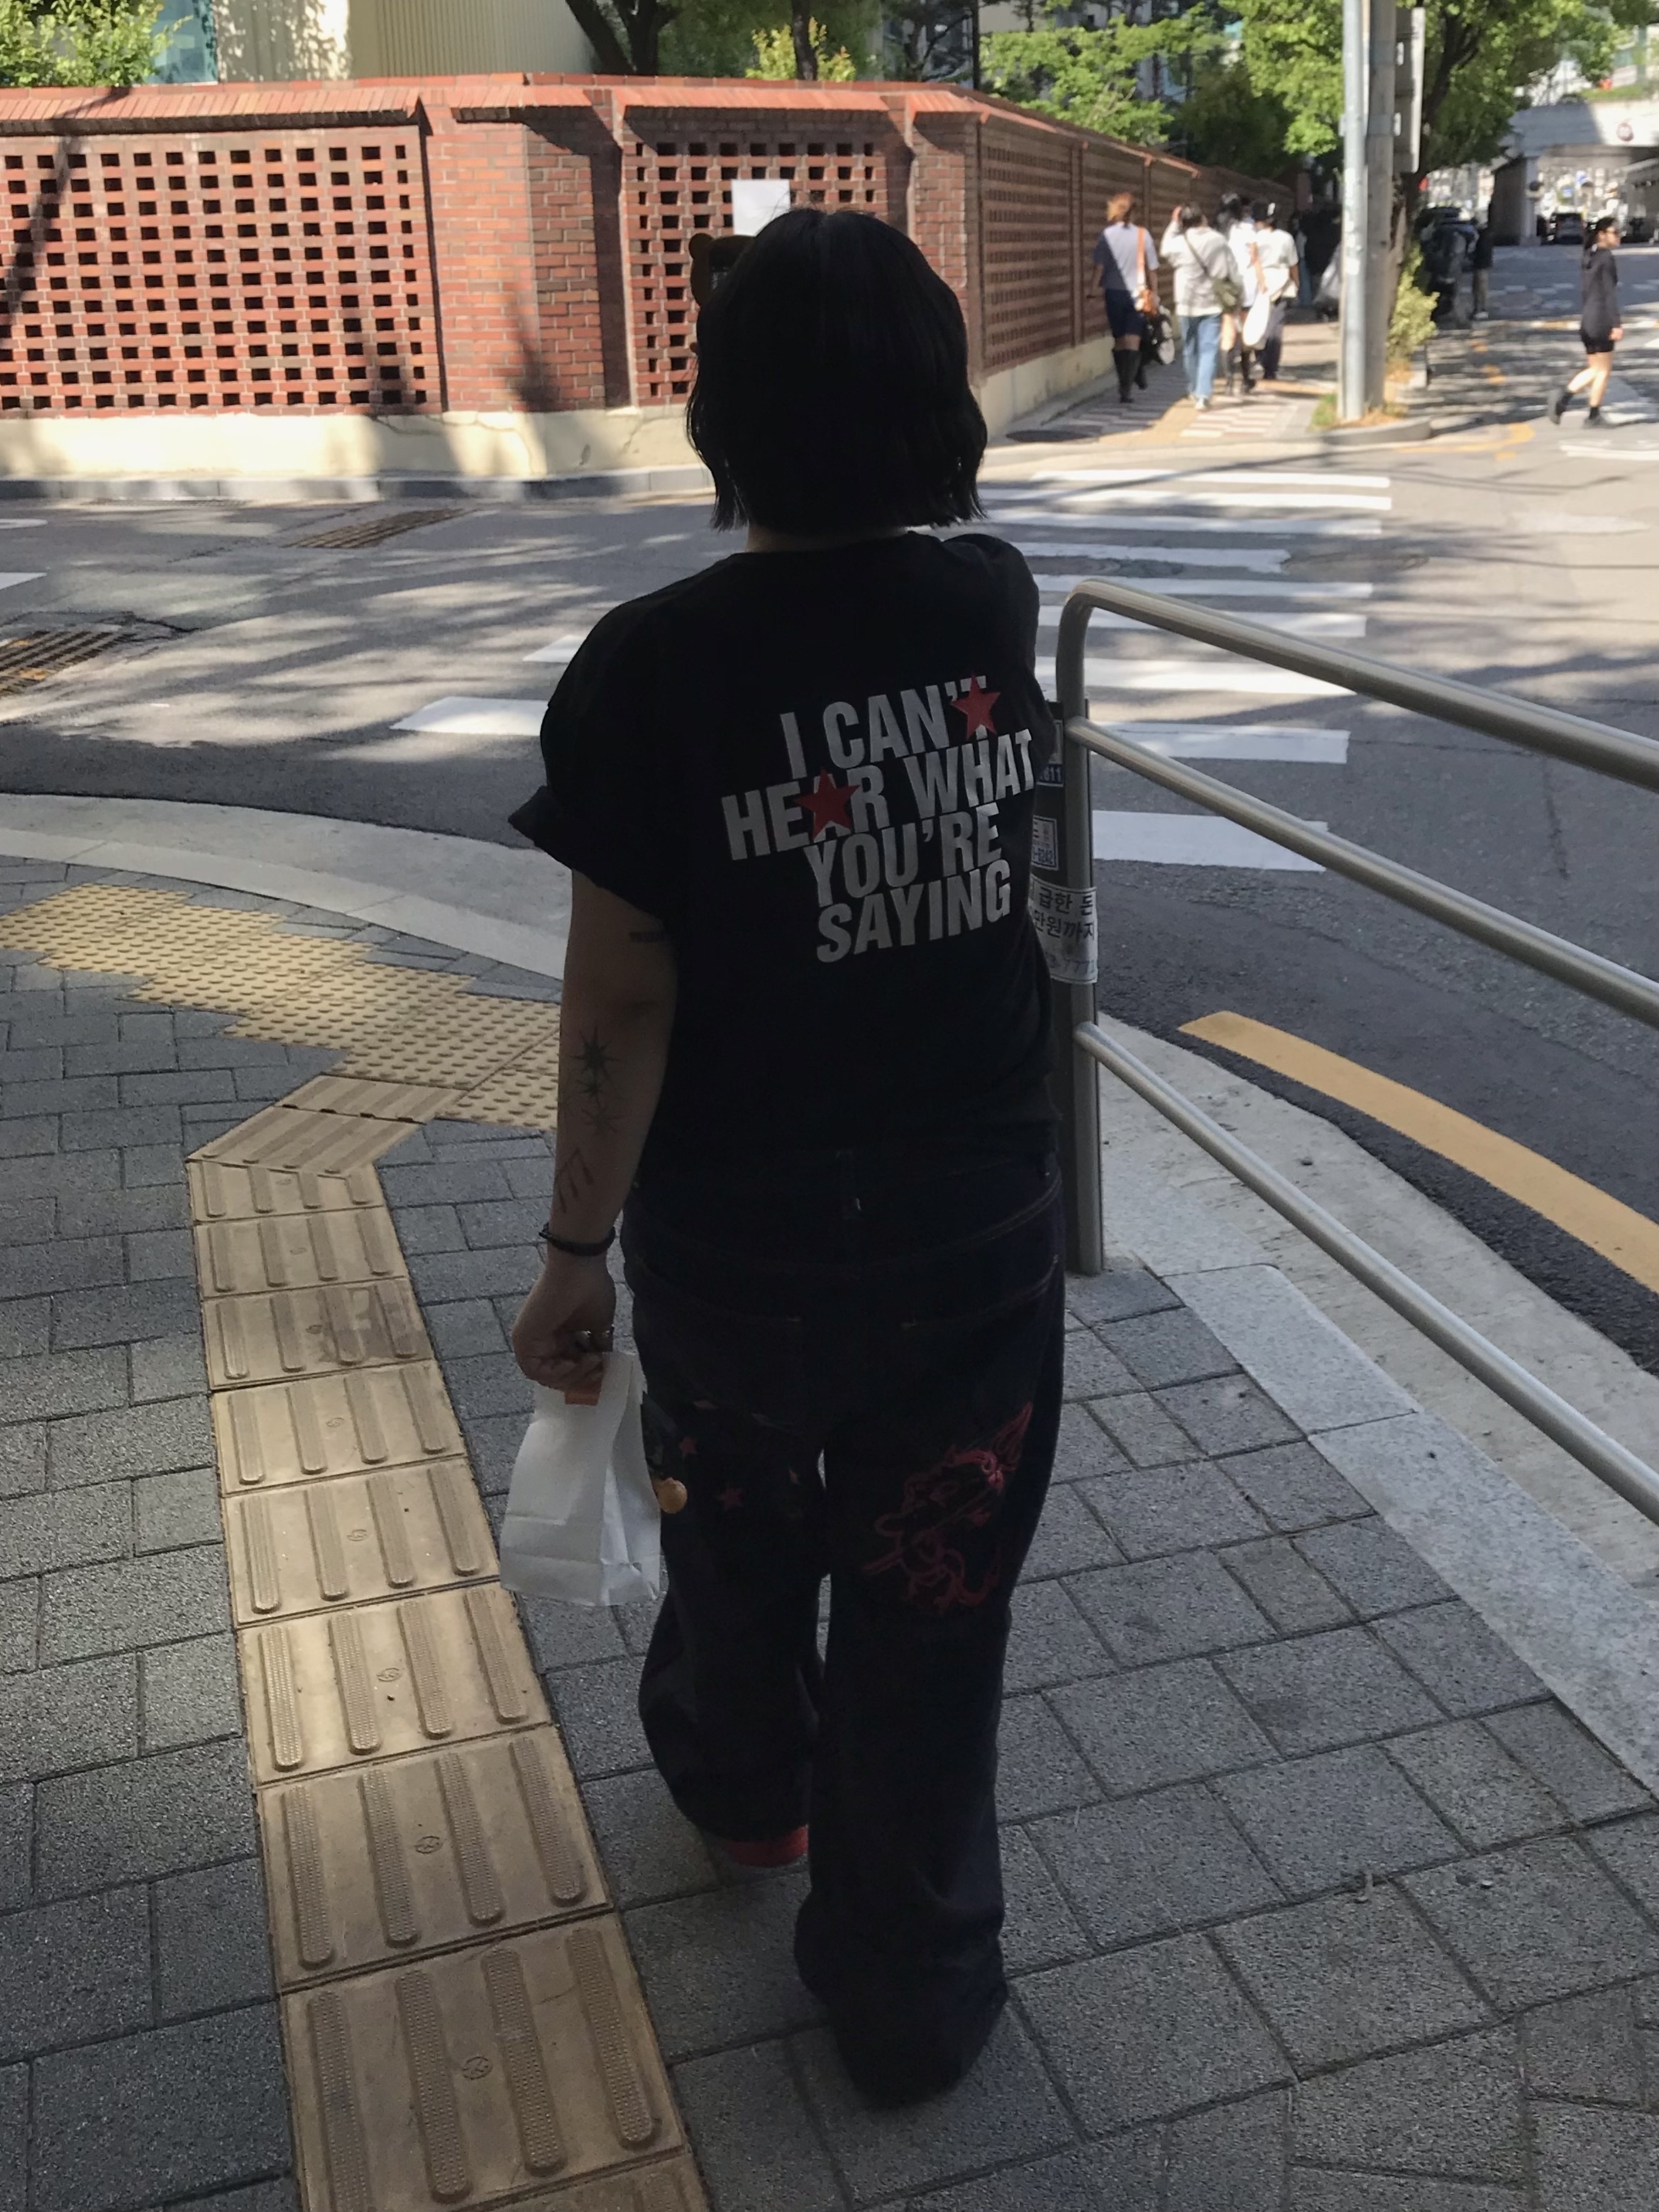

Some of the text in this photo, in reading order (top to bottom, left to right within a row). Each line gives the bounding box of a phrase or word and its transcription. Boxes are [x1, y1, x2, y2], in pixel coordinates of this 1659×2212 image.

[780, 712, 807, 779] I
[903, 729, 1034, 819] WHAT
[804, 802, 1001, 907] YOU'RE
[817, 859, 1010, 963] SAYING
